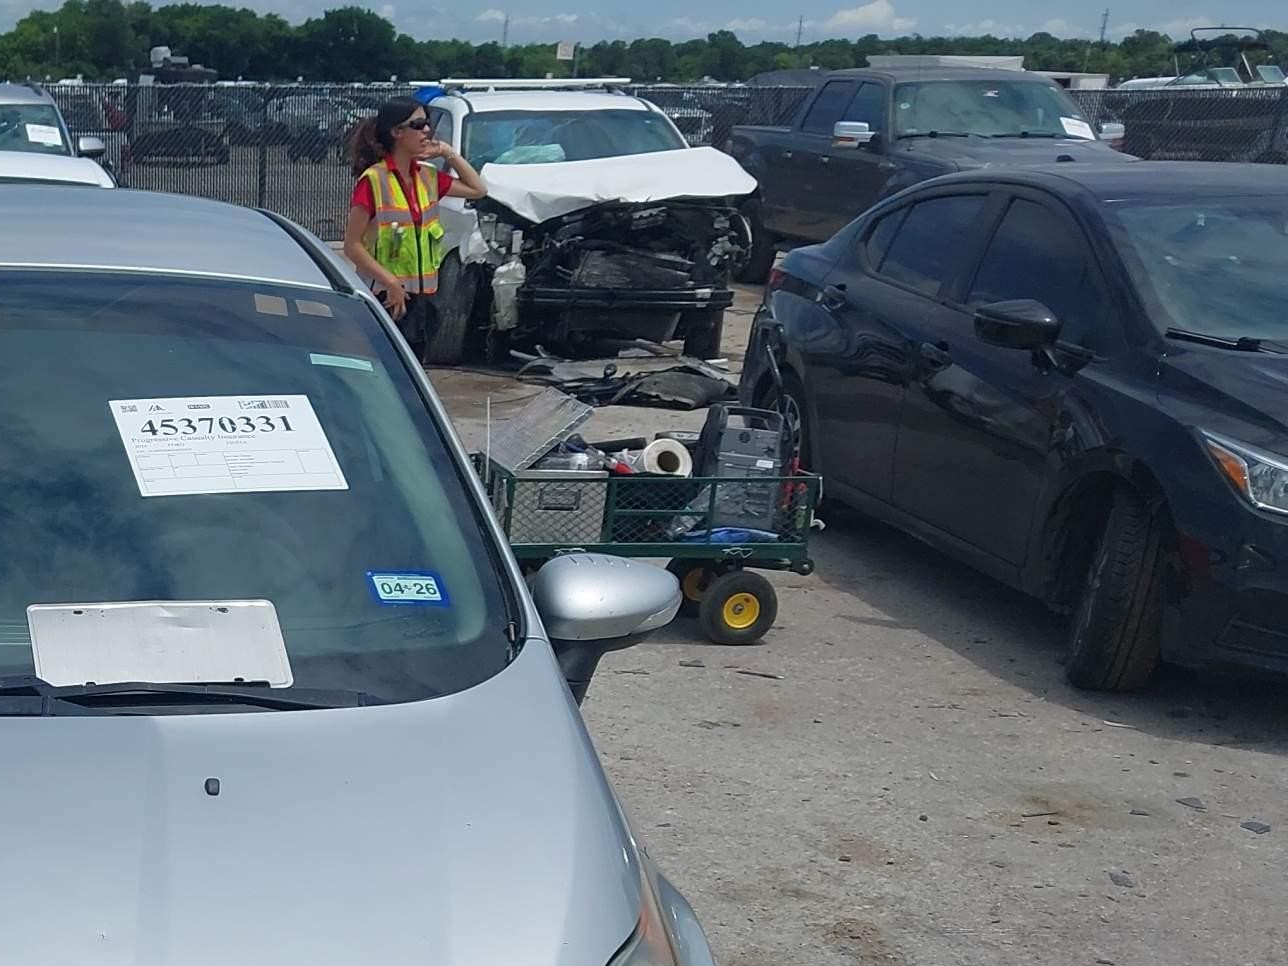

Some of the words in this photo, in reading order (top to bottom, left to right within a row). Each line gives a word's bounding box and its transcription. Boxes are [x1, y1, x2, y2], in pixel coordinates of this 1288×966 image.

[141, 415, 295, 436] 45370331
[380, 582, 405, 594] 04
[413, 583, 437, 595] 26
